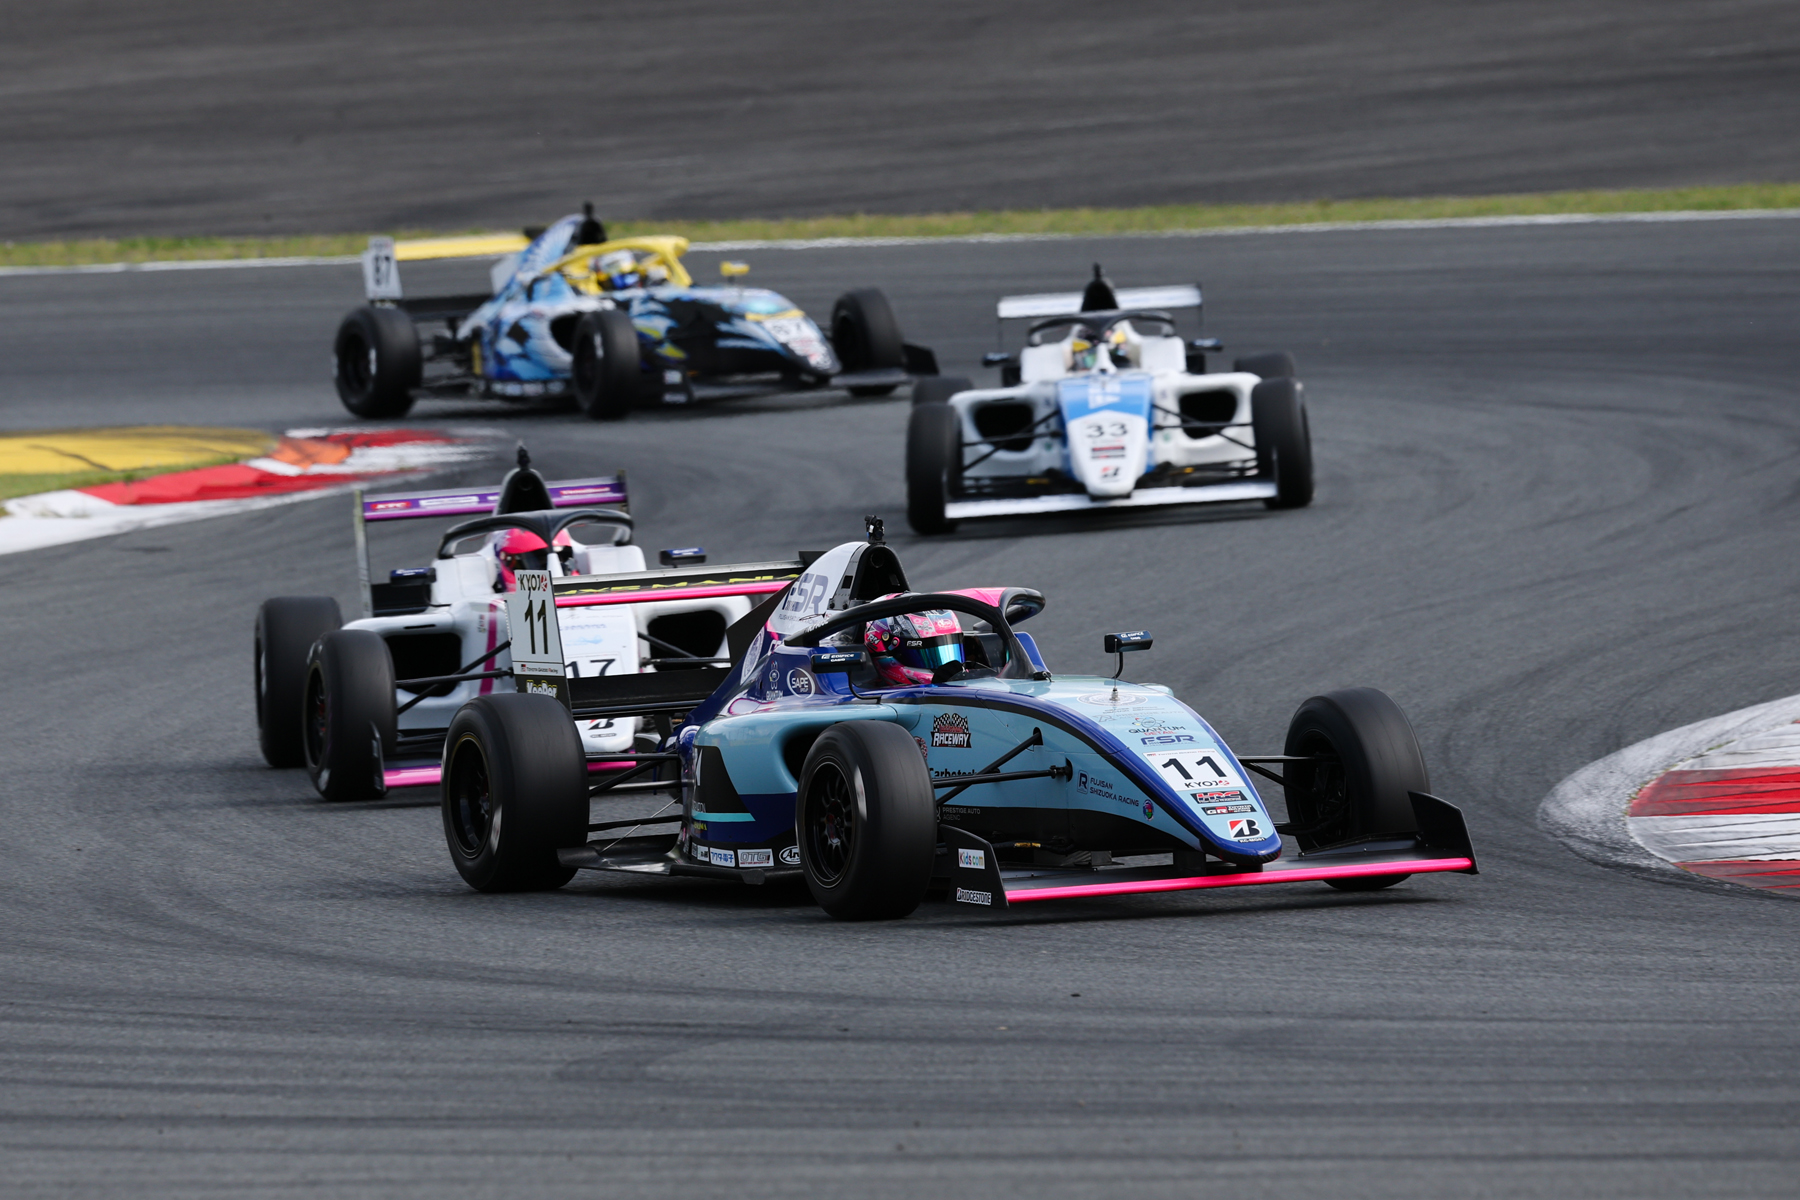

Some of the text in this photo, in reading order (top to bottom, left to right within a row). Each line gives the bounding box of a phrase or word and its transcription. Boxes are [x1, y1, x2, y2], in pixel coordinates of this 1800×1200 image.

[1085, 422, 1128, 438] 33
[524, 600, 548, 655] 11
[565, 658, 616, 678] 17
[791, 676, 809, 689] SAPE
[1128, 726, 1187, 734] QUANTUM
[933, 732, 969, 748] RACEWAY
[1140, 734, 1196, 746] FSR
[1161, 756, 1228, 780] 11
[1090, 777, 1114, 790] FUJISAN
[1090, 786, 1140, 807] SHIZUOKA RACING
[942, 806, 981, 815] PRESTIGE AUTO
[957, 887, 992, 905] BRIDGESTONE
